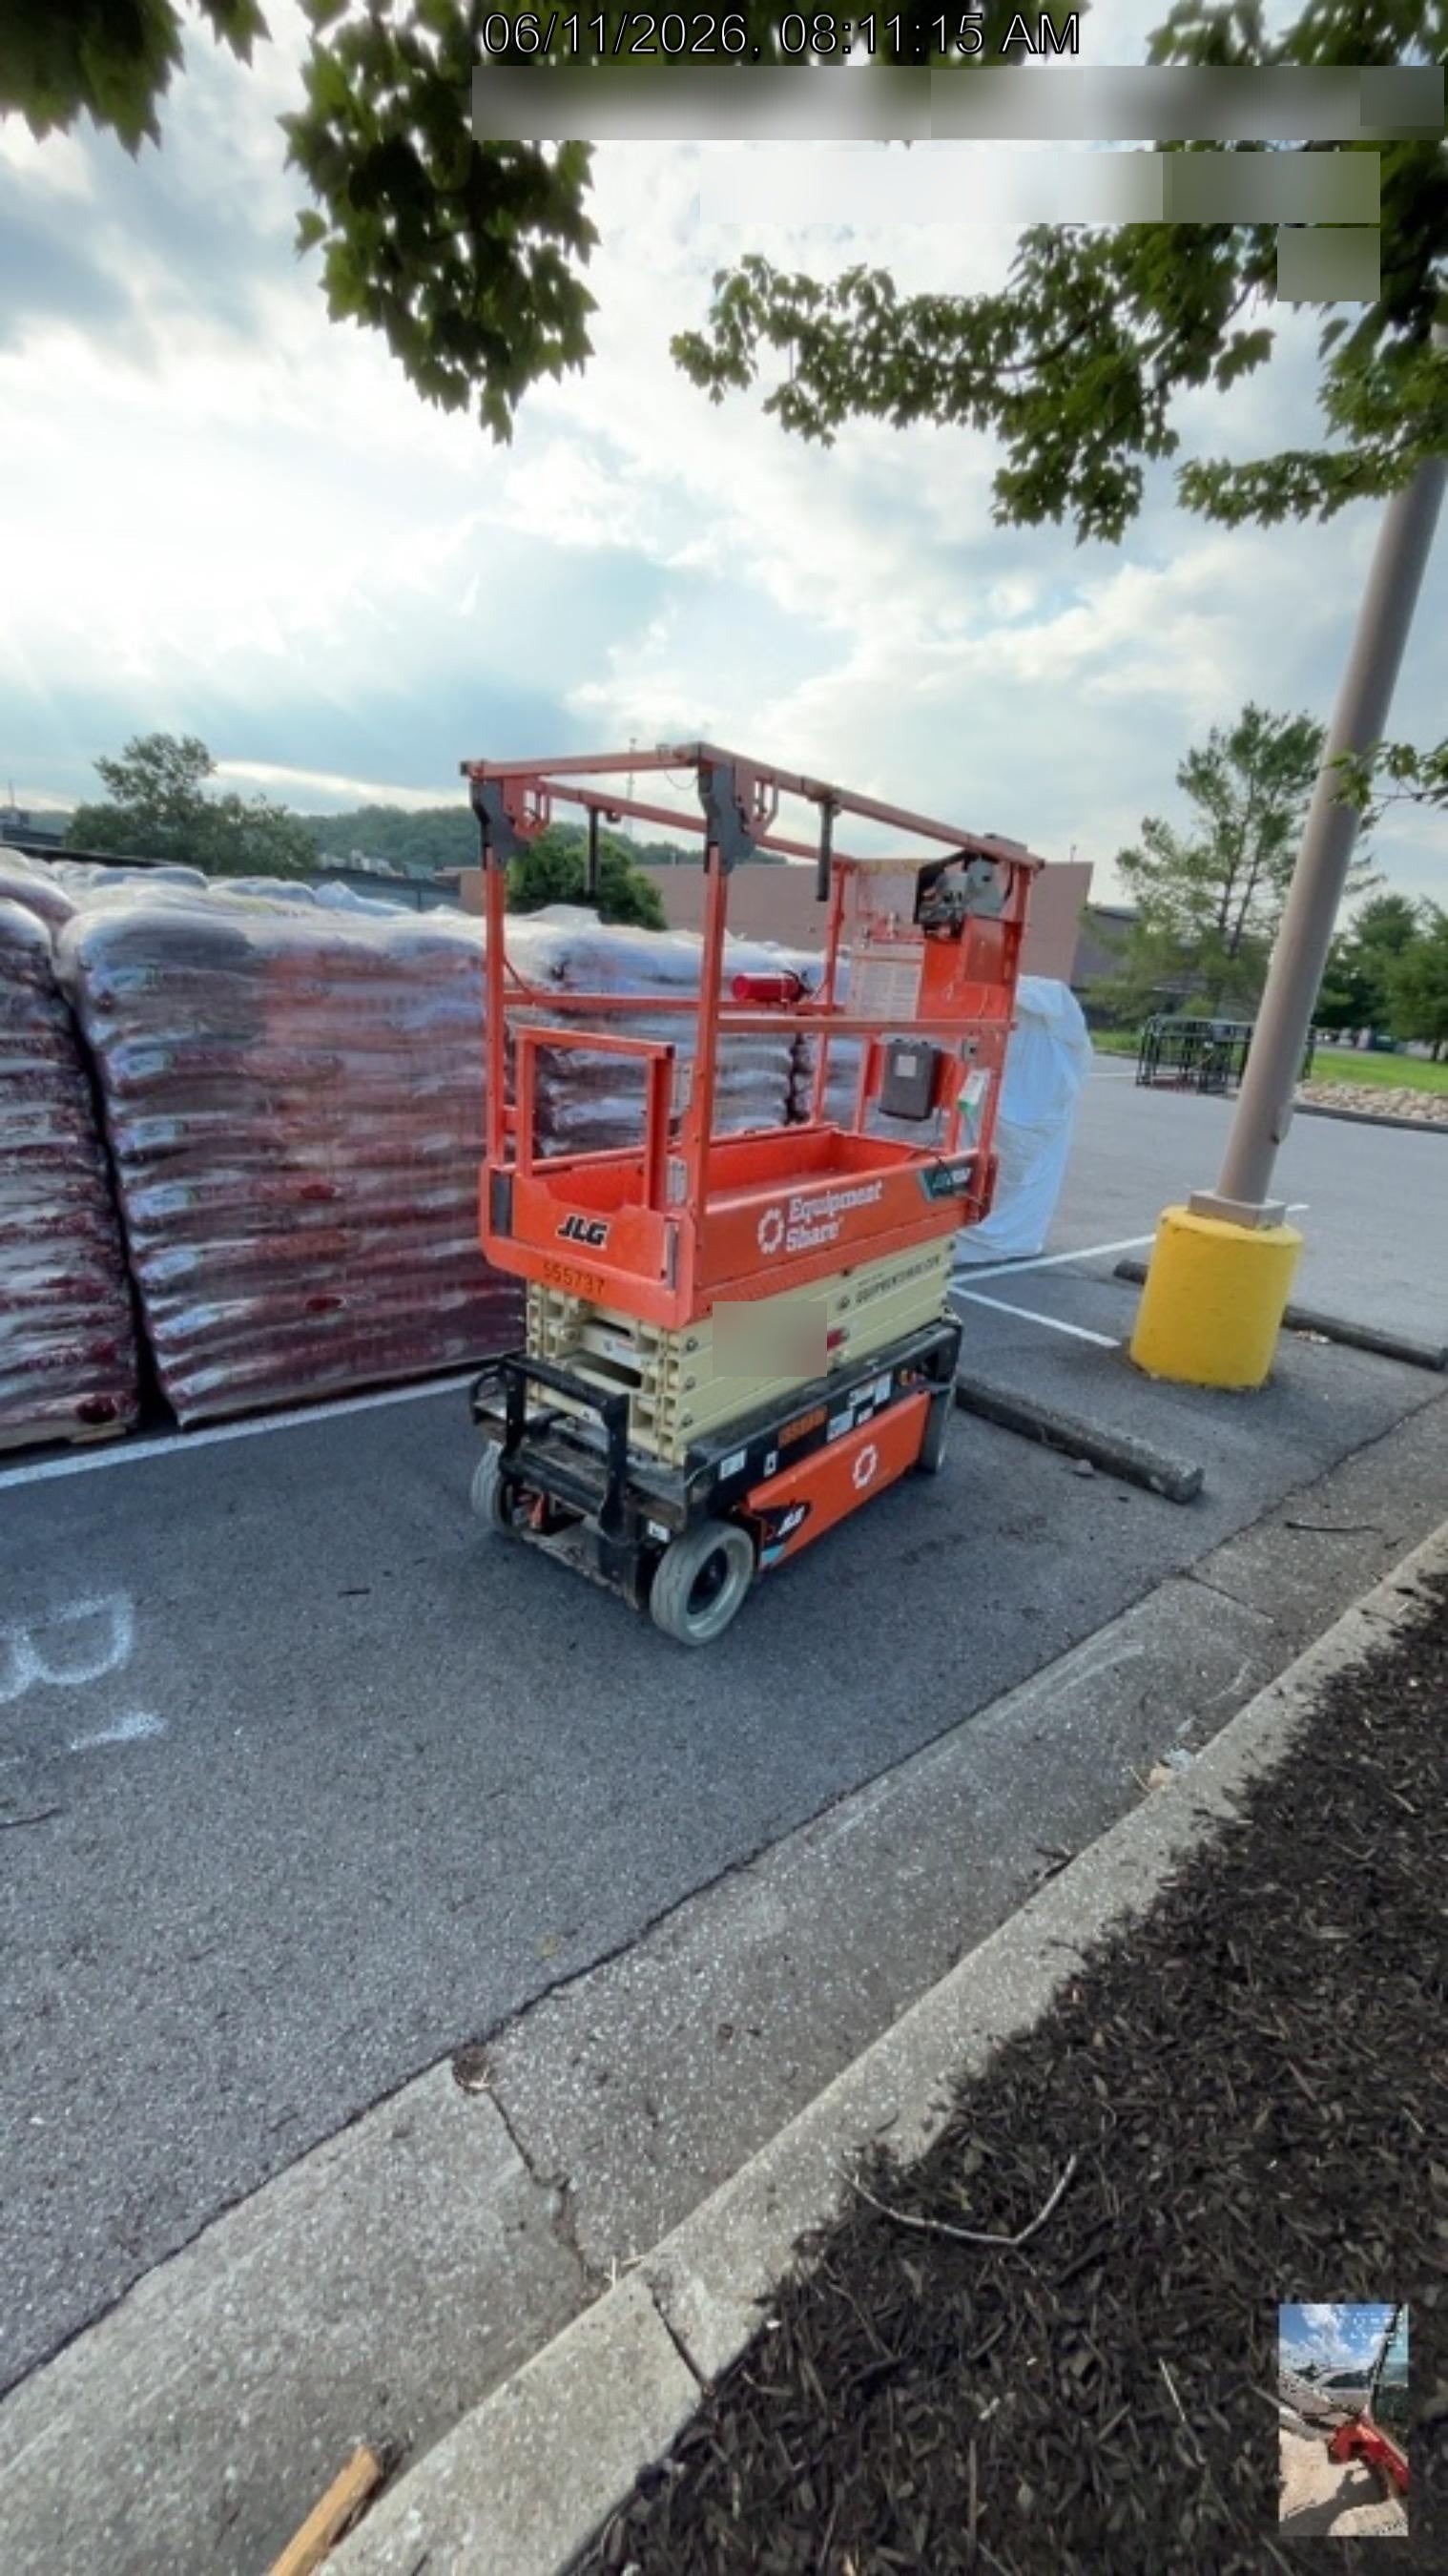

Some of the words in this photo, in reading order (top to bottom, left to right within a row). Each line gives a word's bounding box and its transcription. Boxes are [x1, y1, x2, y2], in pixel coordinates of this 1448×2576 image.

[788, 1179, 883, 1224] Equipment
[556, 1215, 608, 1247] JLG
[786, 1222, 840, 1252] Share
